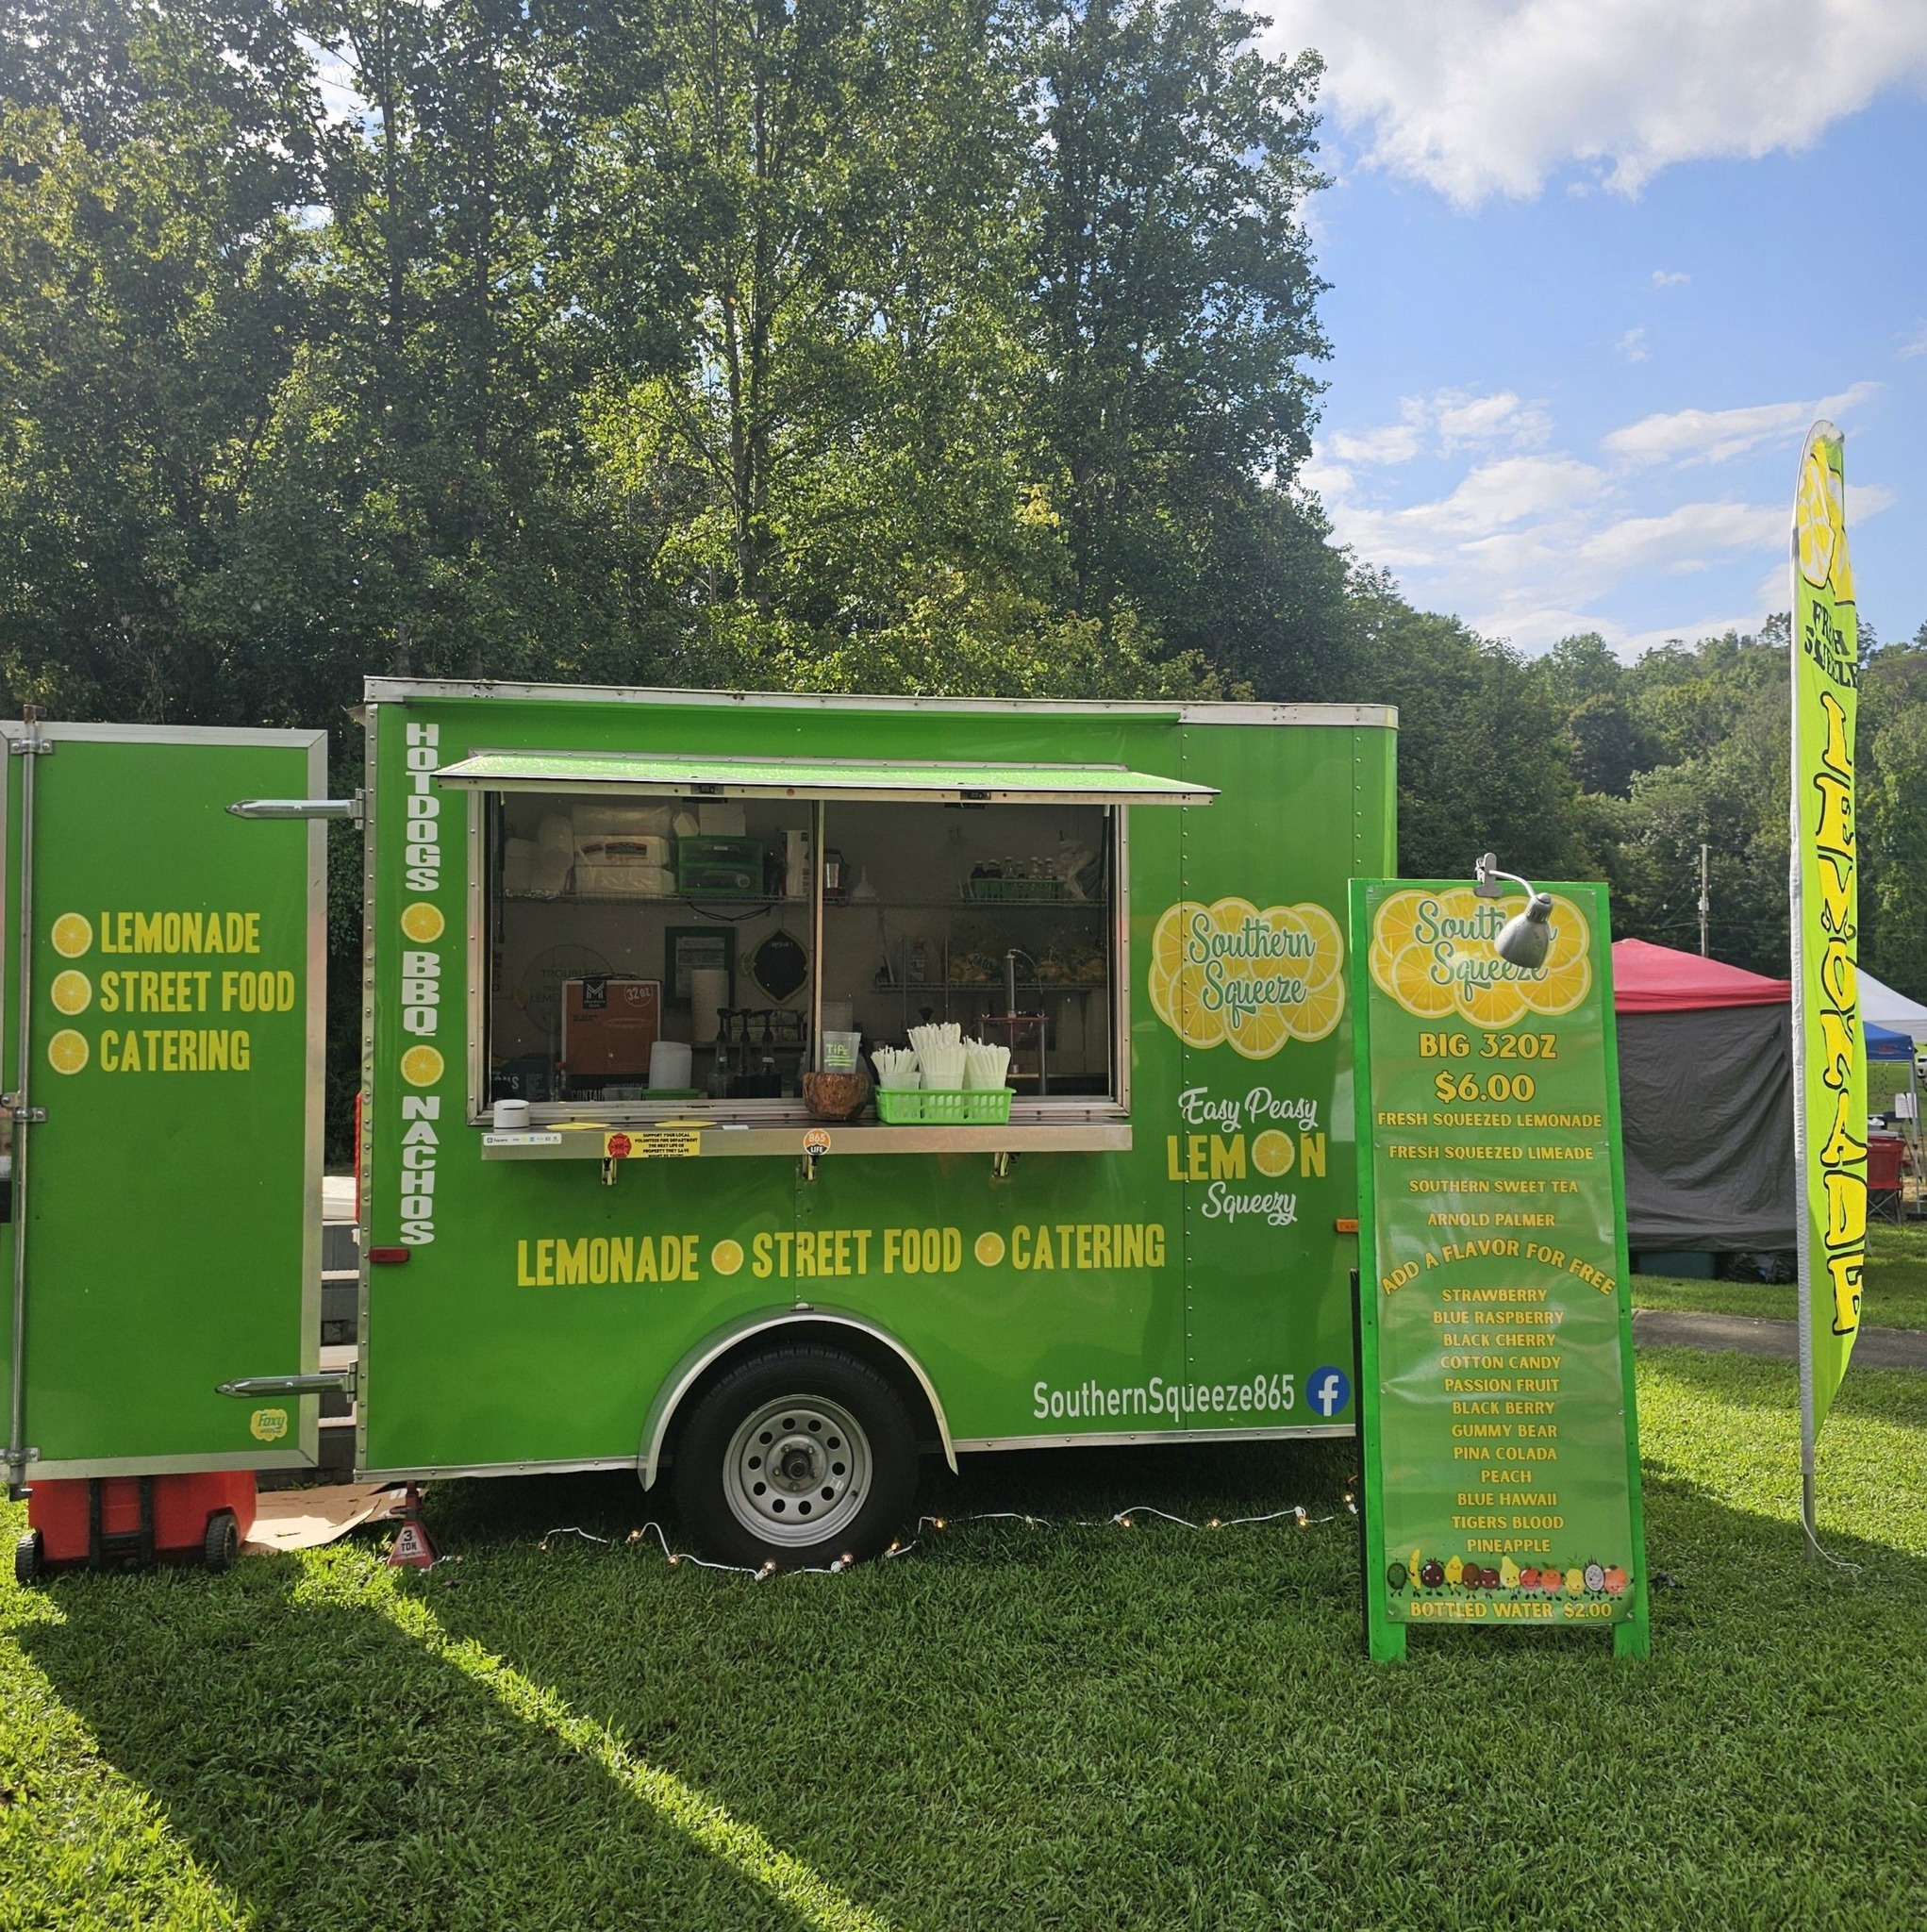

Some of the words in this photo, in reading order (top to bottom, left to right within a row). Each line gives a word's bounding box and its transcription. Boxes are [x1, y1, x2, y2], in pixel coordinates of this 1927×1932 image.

[101, 911, 260, 954] LEMONADE
[1188, 913, 1316, 964] Southern
[1431, 941, 1549, 1002] Squeeze
[100, 971, 211, 1012] STREET
[222, 971, 295, 1012] FOOD
[402, 951, 441, 1037] BBQ
[1202, 960, 1306, 1029] Squeeze
[100, 1030, 250, 1073] CATERING
[1419, 1032, 1470, 1058] BIG
[1479, 1033, 1557, 1059] 32OZ
[1435, 1071, 1535, 1105] $6.00
[1178, 1087, 1241, 1133] Easy
[1244, 1087, 1319, 1132] Peasy
[1378, 1112, 1428, 1126] FRESH
[1433, 1112, 1511, 1127] SQUEEZED
[1517, 1113, 1602, 1127] LEMONADE
[809, 1133, 825, 1142] 865
[1388, 1145, 1439, 1159] FRESH
[1444, 1145, 1522, 1160] SQUEEZED
[1528, 1146, 1594, 1160] LIMEADE
[400, 1095, 441, 1246] NACHOS
[1409, 1180, 1489, 1192] SOUTHERN
[1494, 1180, 1546, 1192] SWEET
[1551, 1181, 1579, 1193] TEA
[1201, 1181, 1298, 1226] Squeezy
[1428, 1213, 1489, 1226] ARNOLD
[1495, 1213, 1555, 1226] PALMER
[517, 1235, 699, 1287] LEMONADE
[753, 1229, 872, 1278] STREET
[884, 1227, 961, 1274] FOOD
[1011, 1224, 1166, 1271] CATERING
[1381, 1260, 1420, 1296] ADD
[1424, 1252, 1439, 1270] A
[1441, 1239, 1520, 1263] FLAVOR
[1526, 1242, 1566, 1268] FOR
[1569, 1257, 1616, 1296] FREE
[1441, 1289, 1547, 1302] STRAWBERRY
[1433, 1311, 1470, 1324] BLUE
[1474, 1311, 1564, 1324] RASPBERRY
[1443, 1333, 1490, 1347] BLACK
[1495, 1333, 1555, 1346] CHERRY
[1440, 1356, 1503, 1369] COTTON
[1509, 1356, 1561, 1369] CANDY
[1444, 1378, 1512, 1391] PASSION
[1517, 1378, 1560, 1391] FRUIT
[1034, 1374, 1295, 1423] SouthernSqueeze865
[1452, 1402, 1501, 1415] BLACK
[1505, 1402, 1555, 1415] BERRY
[257, 1413, 286, 1428] Foxy
[1452, 1424, 1513, 1439] GUMMY
[1518, 1424, 1558, 1438] BEAR
[1453, 1447, 1489, 1460] PINA
[1495, 1447, 1557, 1460] COLADA
[1481, 1470, 1532, 1484] PEACH
[1457, 1492, 1494, 1507] BLUE
[1500, 1492, 1557, 1506] HAWAII
[1452, 1515, 1507, 1529] TIGERS
[1512, 1515, 1565, 1529] BLOOD
[404, 1530, 412, 1541] 3
[401, 1542, 417, 1551] TON
[1467, 1539, 1551, 1553] PINEAPPLE
[1410, 1602, 1487, 1617] BOTTLED
[1494, 1602, 1553, 1617] WATER
[1564, 1602, 1612, 1619] $2.00
